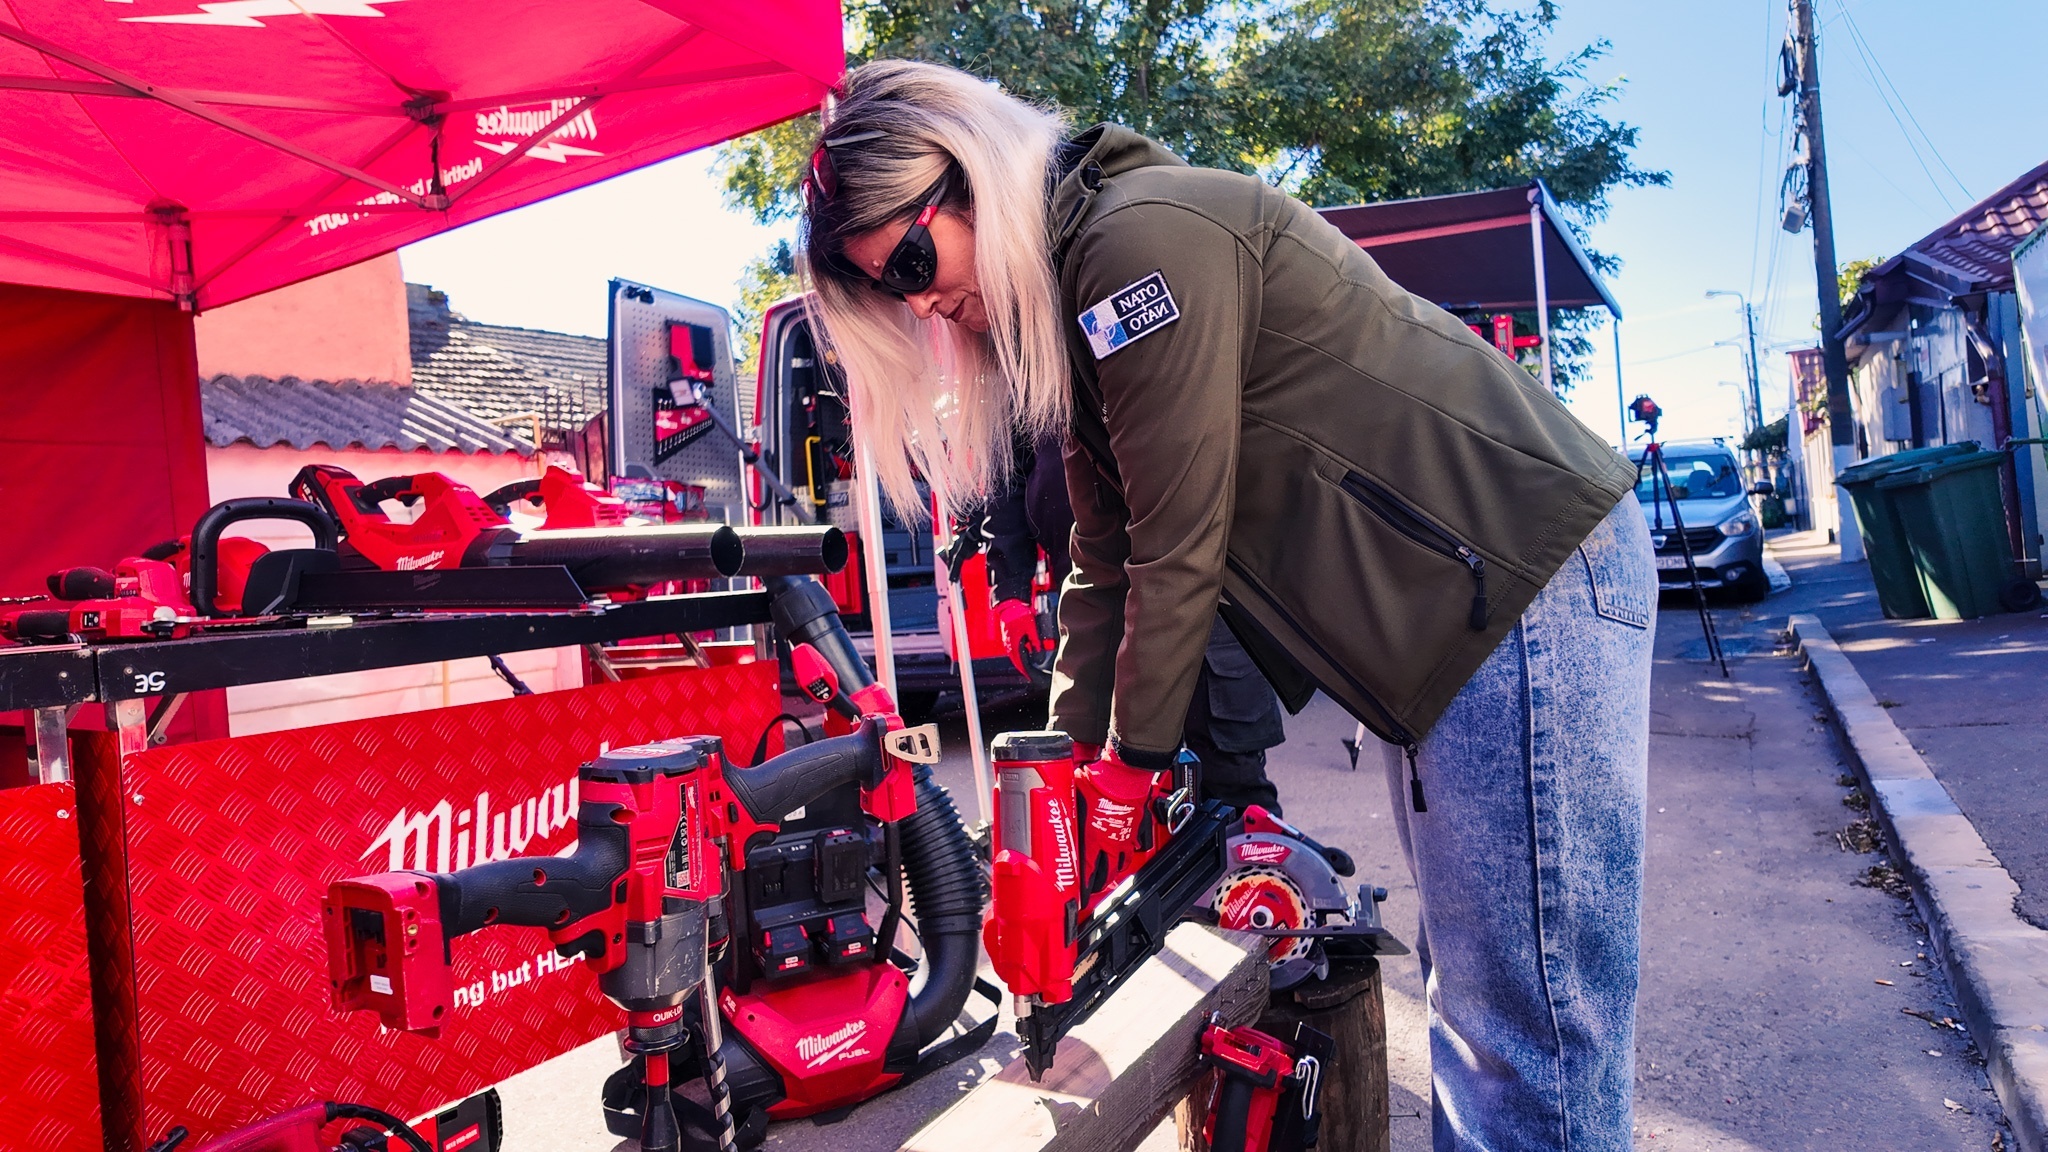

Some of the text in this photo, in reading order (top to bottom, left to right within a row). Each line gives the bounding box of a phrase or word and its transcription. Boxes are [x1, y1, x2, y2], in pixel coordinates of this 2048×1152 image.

[1118, 283, 1158, 312] NATO
[1129, 301, 1169, 331] OTAN
[396, 550, 444, 570] Milwaukee
[1048, 798, 1075, 892] Milwaukee
[1241, 844, 1285, 857] Milwaukee
[491, 961, 531, 994] but
[795, 1020, 866, 1060] Milwaukee
[839, 1048, 870, 1061] FUEL
